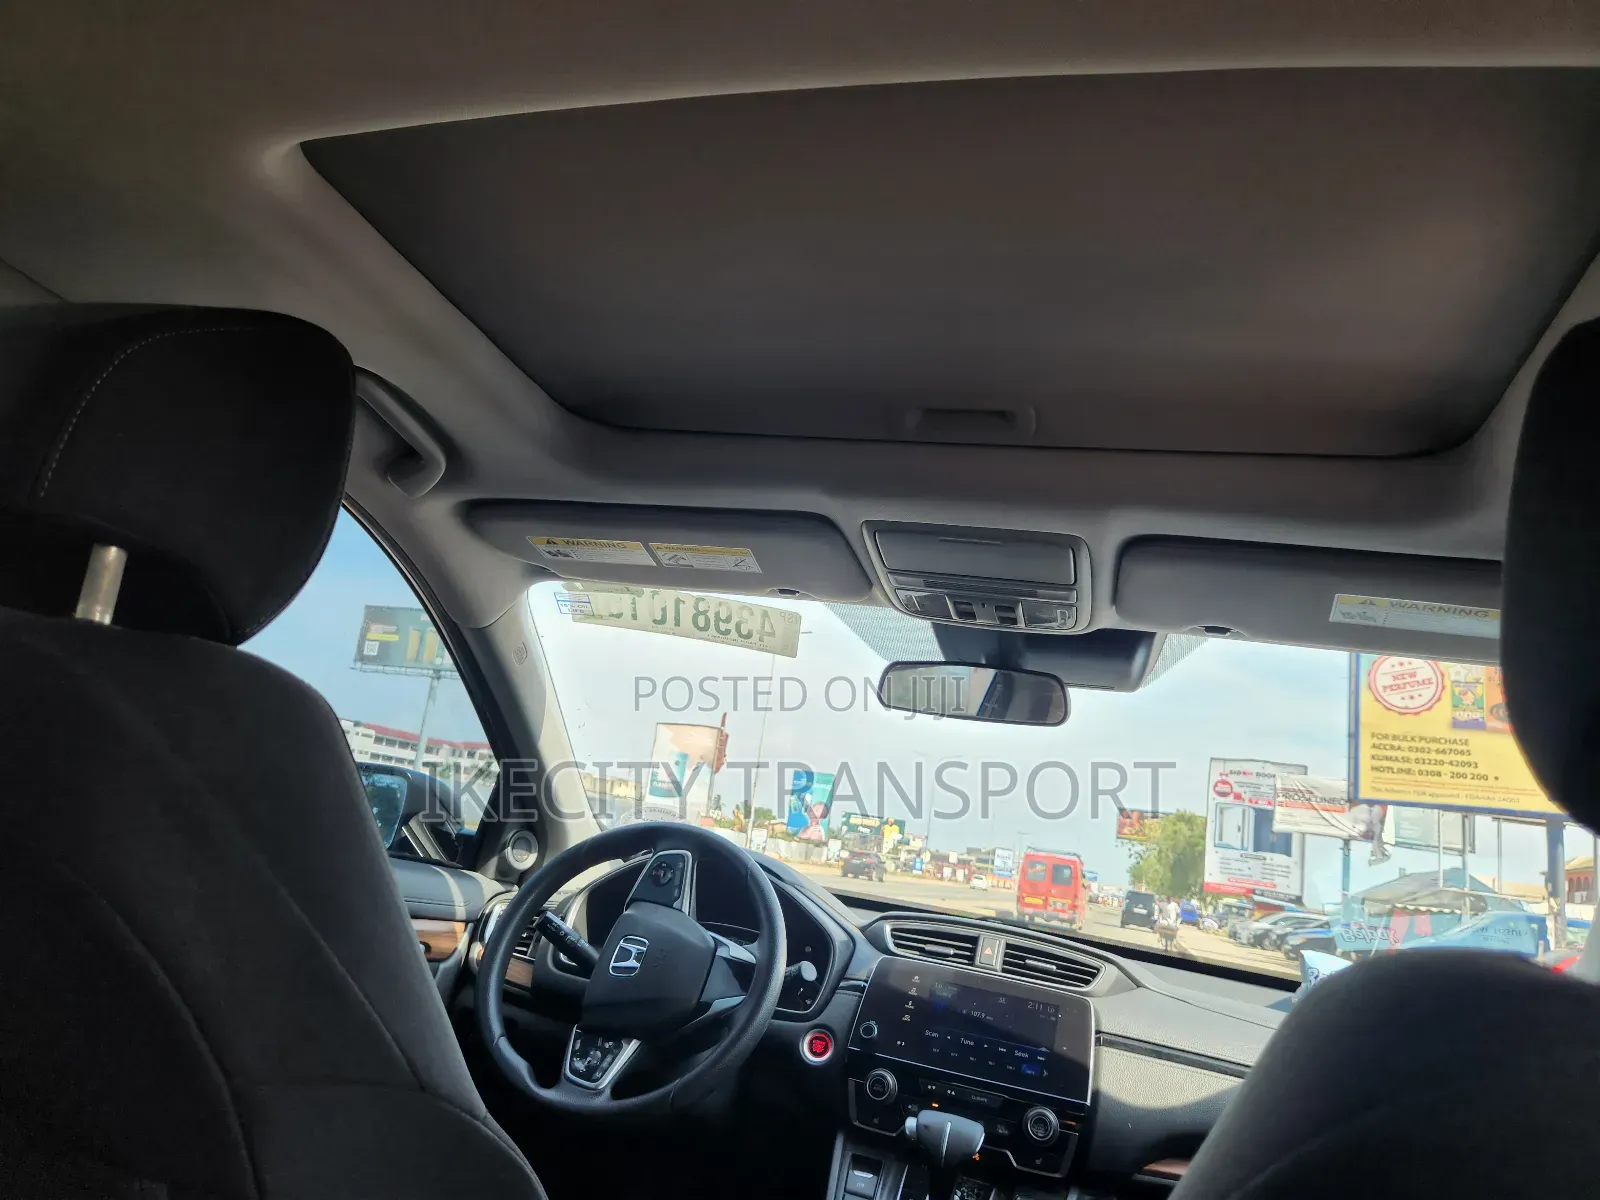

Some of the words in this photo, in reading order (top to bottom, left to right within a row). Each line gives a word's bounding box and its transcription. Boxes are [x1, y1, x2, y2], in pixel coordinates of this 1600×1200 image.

[562, 539, 628, 550] WARNING
[1389, 601, 1490, 618] WARNING
[1391, 671, 1418, 682] NEW
[1382, 677, 1434, 692] PERFUME
[1371, 731, 1391, 741] FOR
[1391, 733, 1417, 743] BULK
[1418, 734, 1470, 746] PURCHASE
[1027, 1001, 1043, 1011] 2:11
[970, 1010, 986, 1019] 107.9
[925, 1029, 939, 1038] Scan
[960, 1037, 975, 1046] Tune
[1014, 1050, 1029, 1059] Seek
